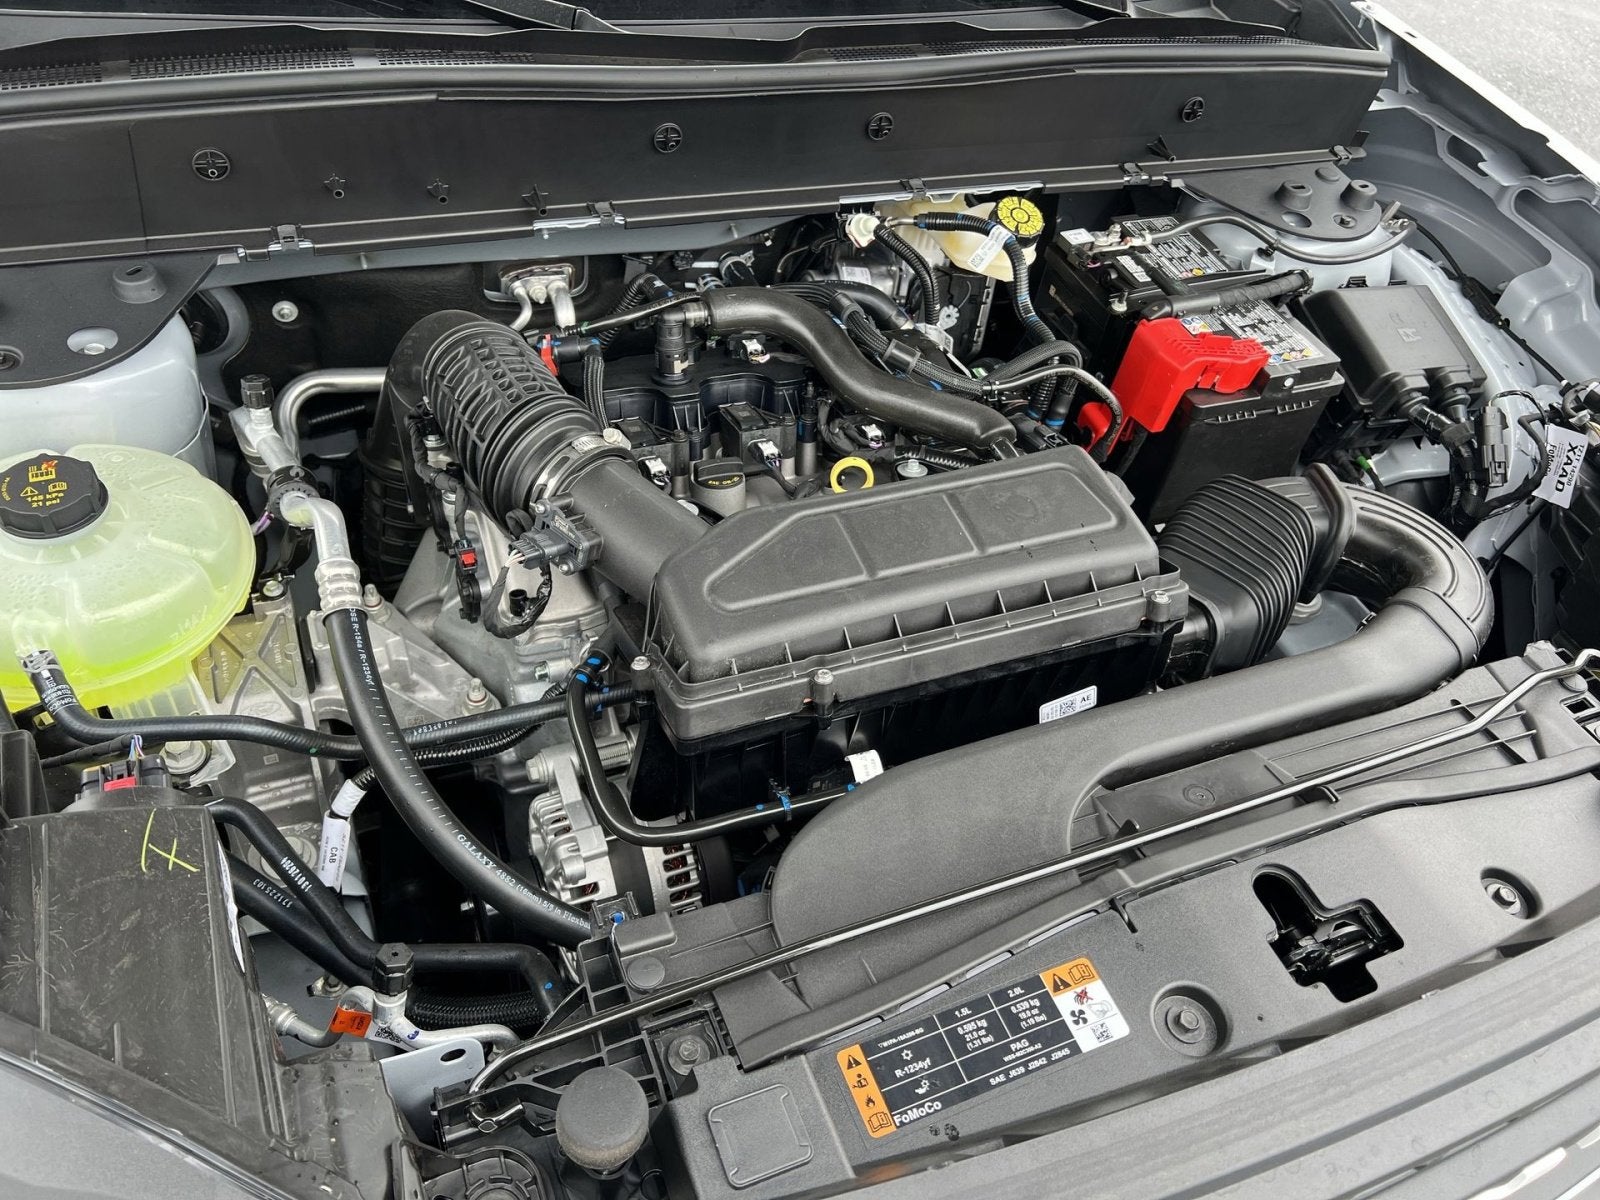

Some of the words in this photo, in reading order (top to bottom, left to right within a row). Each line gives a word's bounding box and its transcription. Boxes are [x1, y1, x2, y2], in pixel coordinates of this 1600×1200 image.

[1546, 444, 1557, 476] FoMoC
[1555, 442, 1578, 492] XAAD
[1081, 694, 1092, 703] AE
[328, 846, 337, 864] CAB
[457, 834, 497, 869] GALAXY
[496, 869, 516, 888] 4882
[1007, 986, 1025, 998] 2.0L
[955, 1007, 972, 1018] 1.5L
[1028, 998, 1040, 1009] kg
[976, 1018, 987, 1030] kg
[1010, 1039, 1029, 1052] PAG
[894, 1058, 932, 1078] R-1234yf
[989, 1074, 1006, 1086] SAE
[1008, 1066, 1026, 1079] J639
[893, 1100, 942, 1126] FoMoCo
